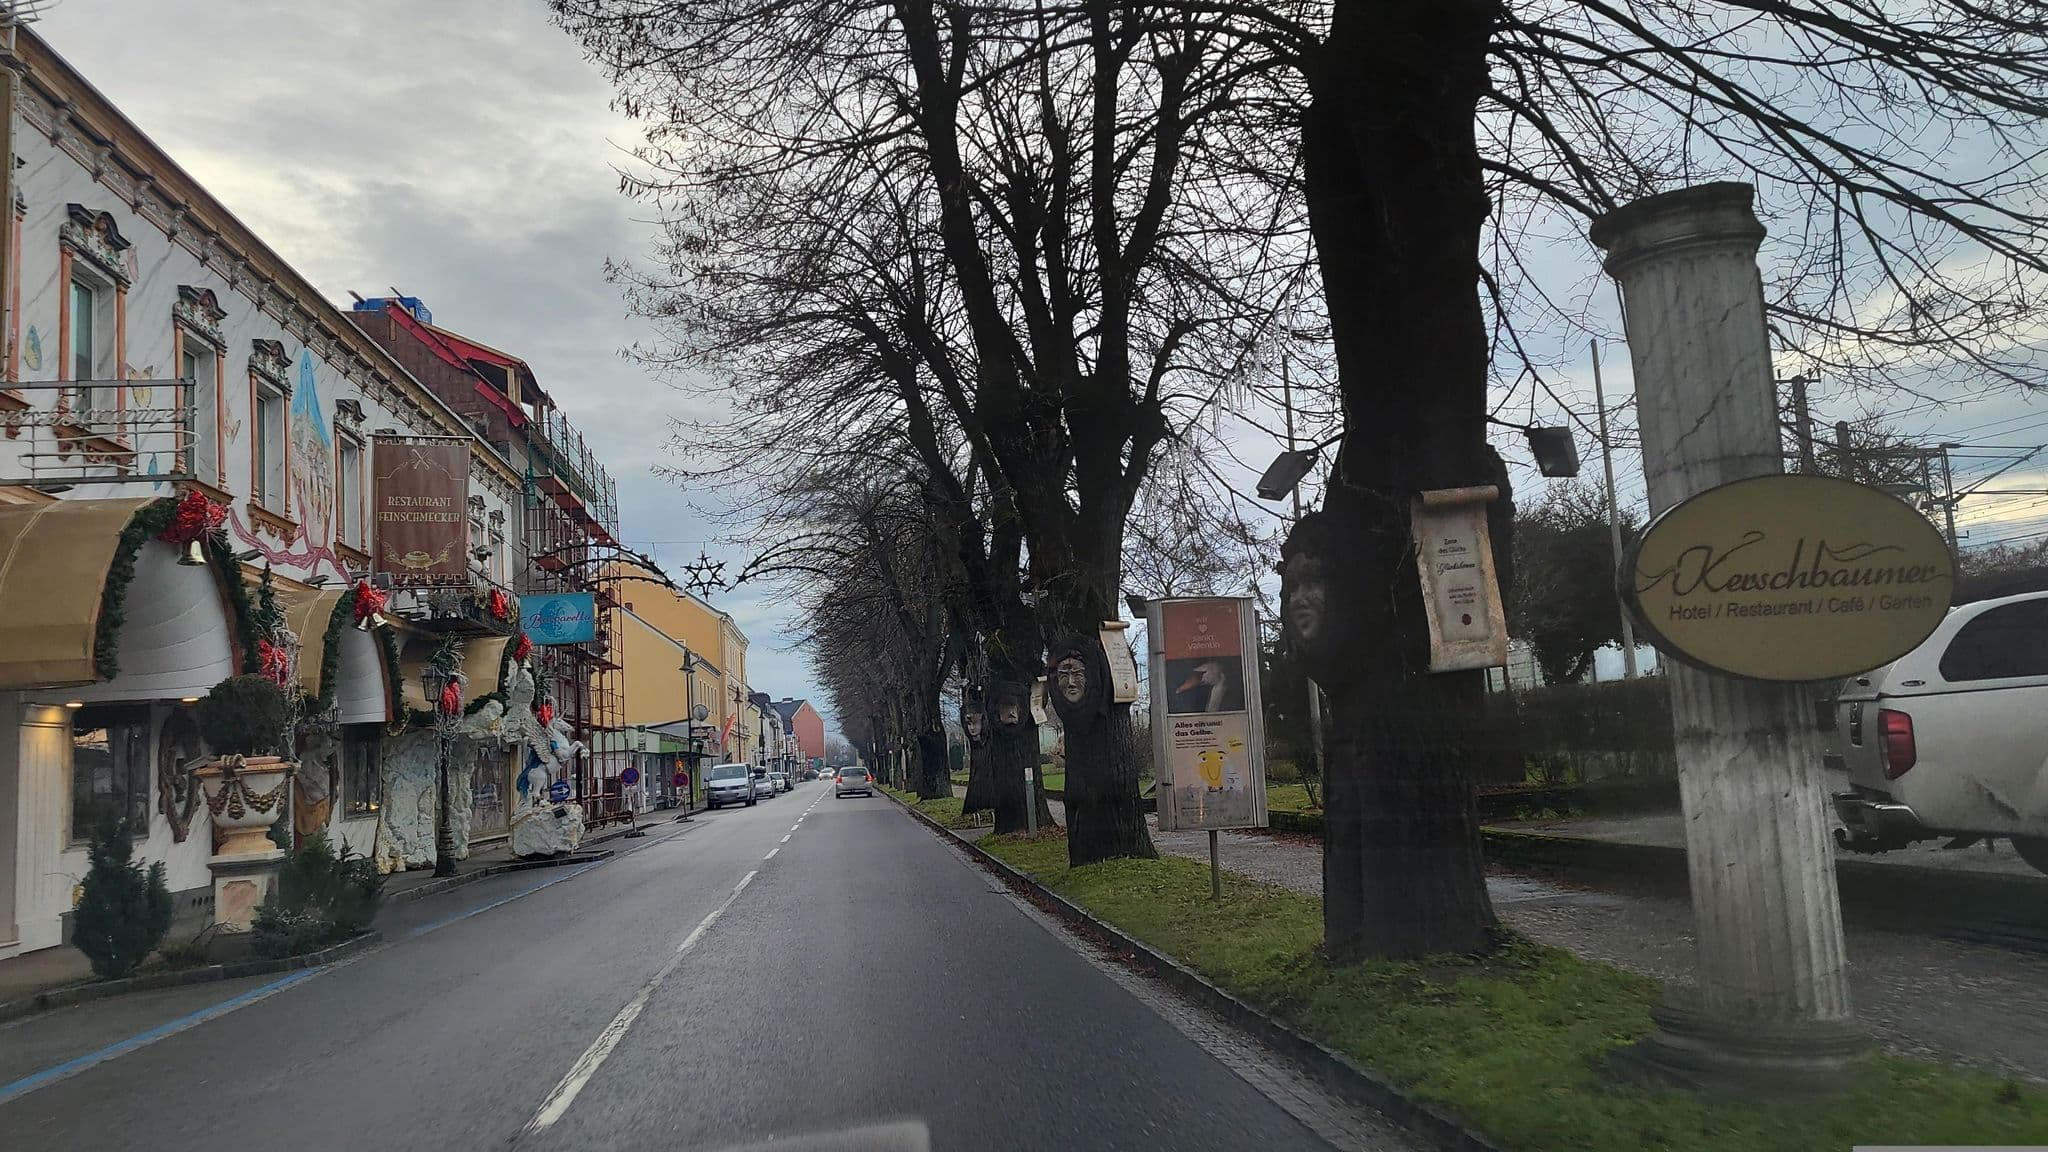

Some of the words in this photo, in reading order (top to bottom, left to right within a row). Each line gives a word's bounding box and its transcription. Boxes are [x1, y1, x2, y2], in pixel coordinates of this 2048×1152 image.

[388, 496, 452, 507] RESTAURANT
[378, 511, 460, 522] FEINSCHMECKER
[1672, 531, 1938, 596] Kerschbaumer
[1669, 604, 1712, 621] Hotel
[1727, 599, 1813, 618] Restaurant
[1828, 597, 1864, 614] Café
[1879, 595, 1933, 611] Garten
